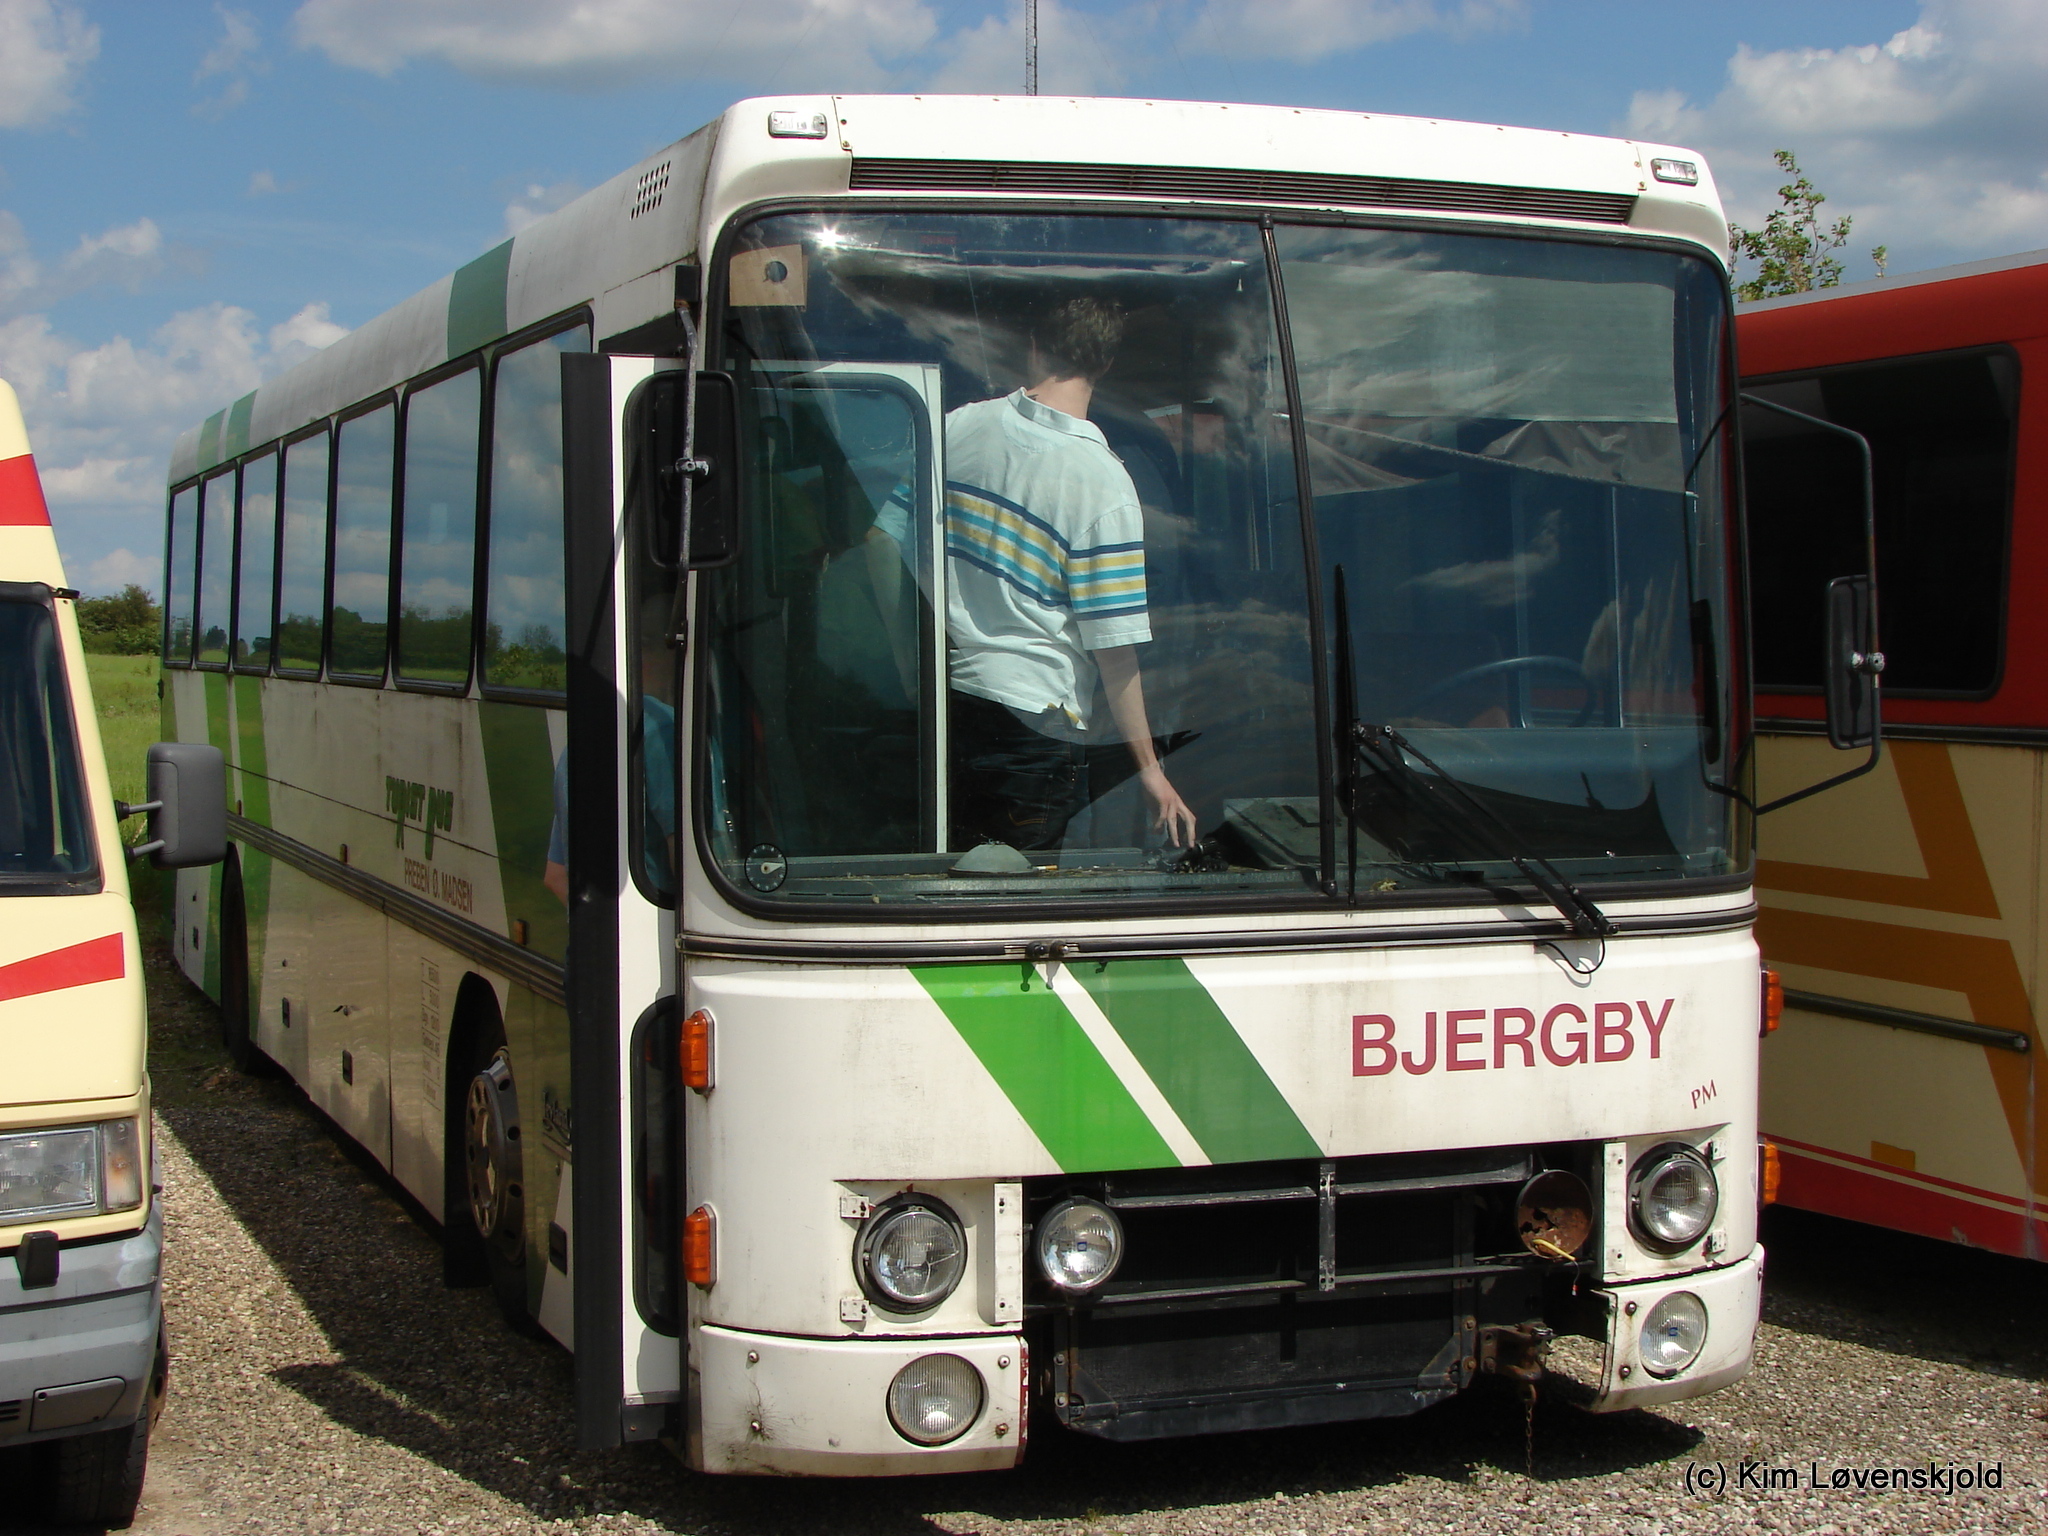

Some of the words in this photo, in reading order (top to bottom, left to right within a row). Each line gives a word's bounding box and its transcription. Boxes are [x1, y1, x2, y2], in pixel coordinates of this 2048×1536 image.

[404, 856, 430, 895] PREBEN
[441, 871, 473, 915] MADSEN
[1352, 998, 1676, 1077] BJERGBY
[1690, 1079, 1718, 1109] PM
